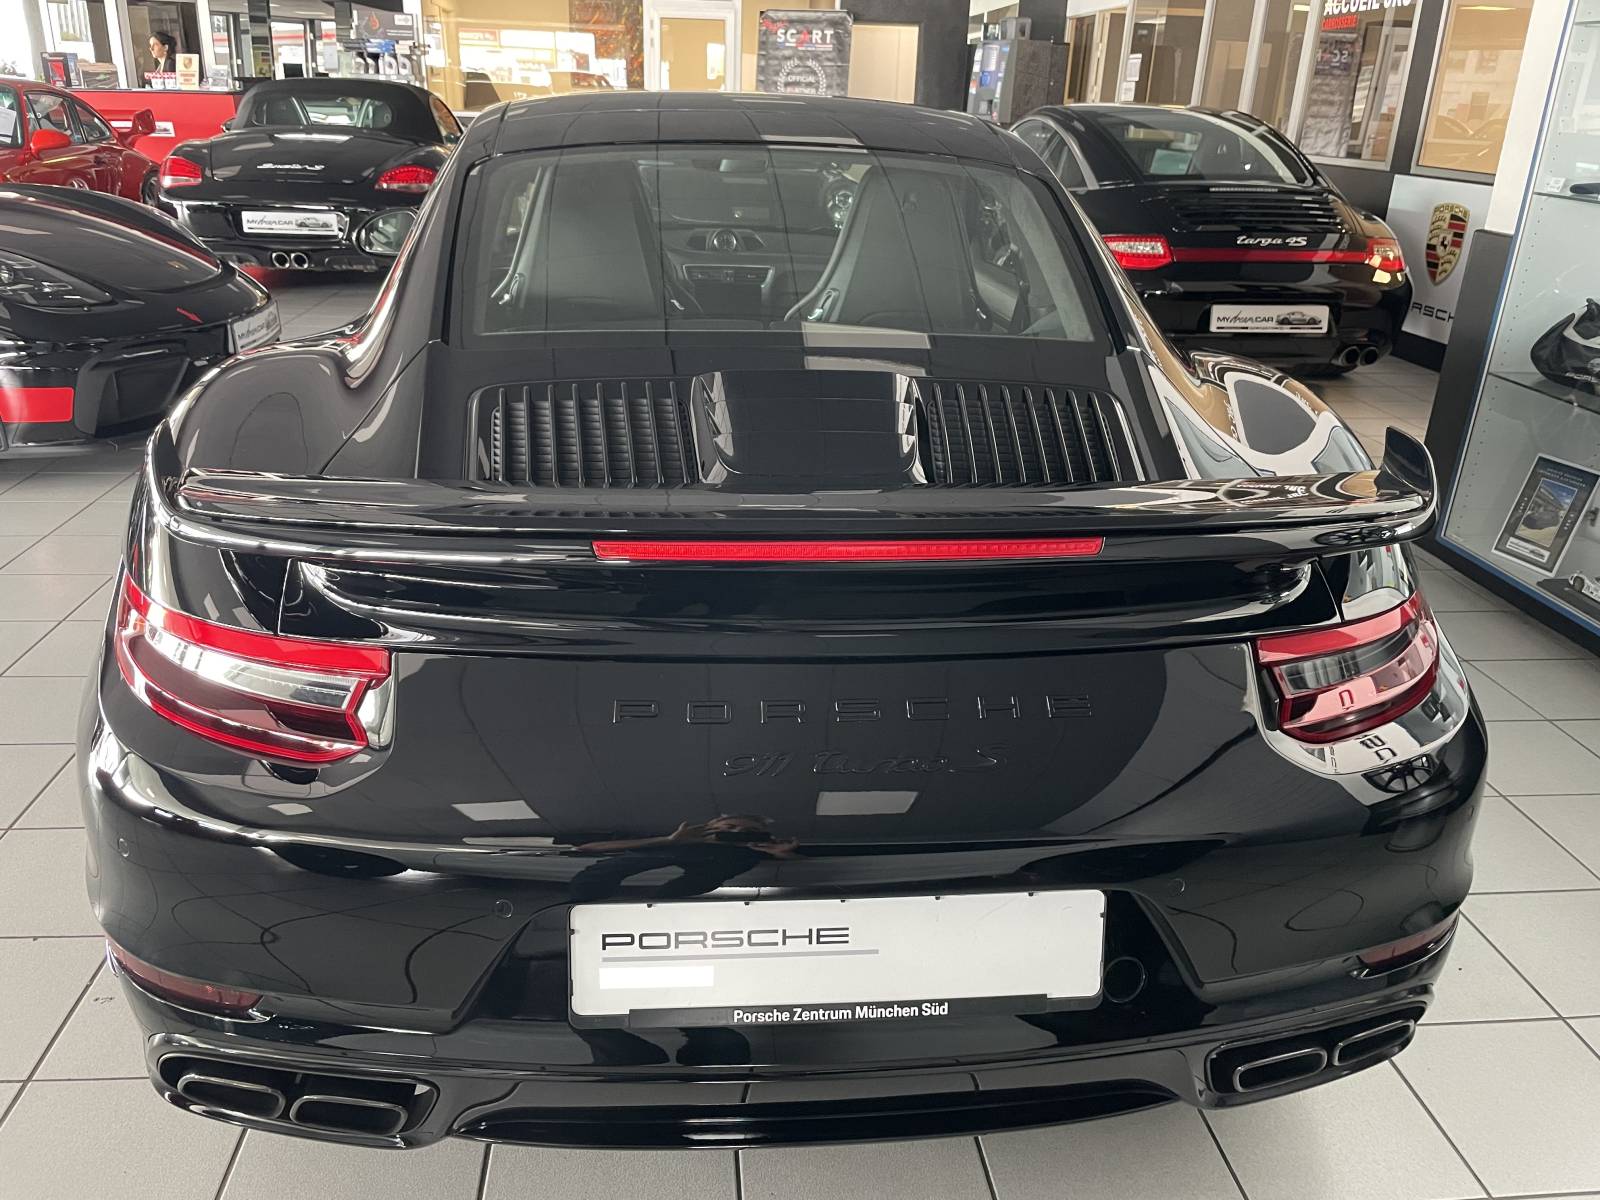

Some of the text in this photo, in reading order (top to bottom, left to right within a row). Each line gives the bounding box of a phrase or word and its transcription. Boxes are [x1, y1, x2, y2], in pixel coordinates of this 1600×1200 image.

[1285, 236, 1307, 246] 4S
[611, 693, 1094, 725] PORSCHE
[720, 751, 794, 777] 911
[601, 926, 850, 952] PORSCHE
[733, 1002, 949, 1024] Porsche Zentrum München Süd
